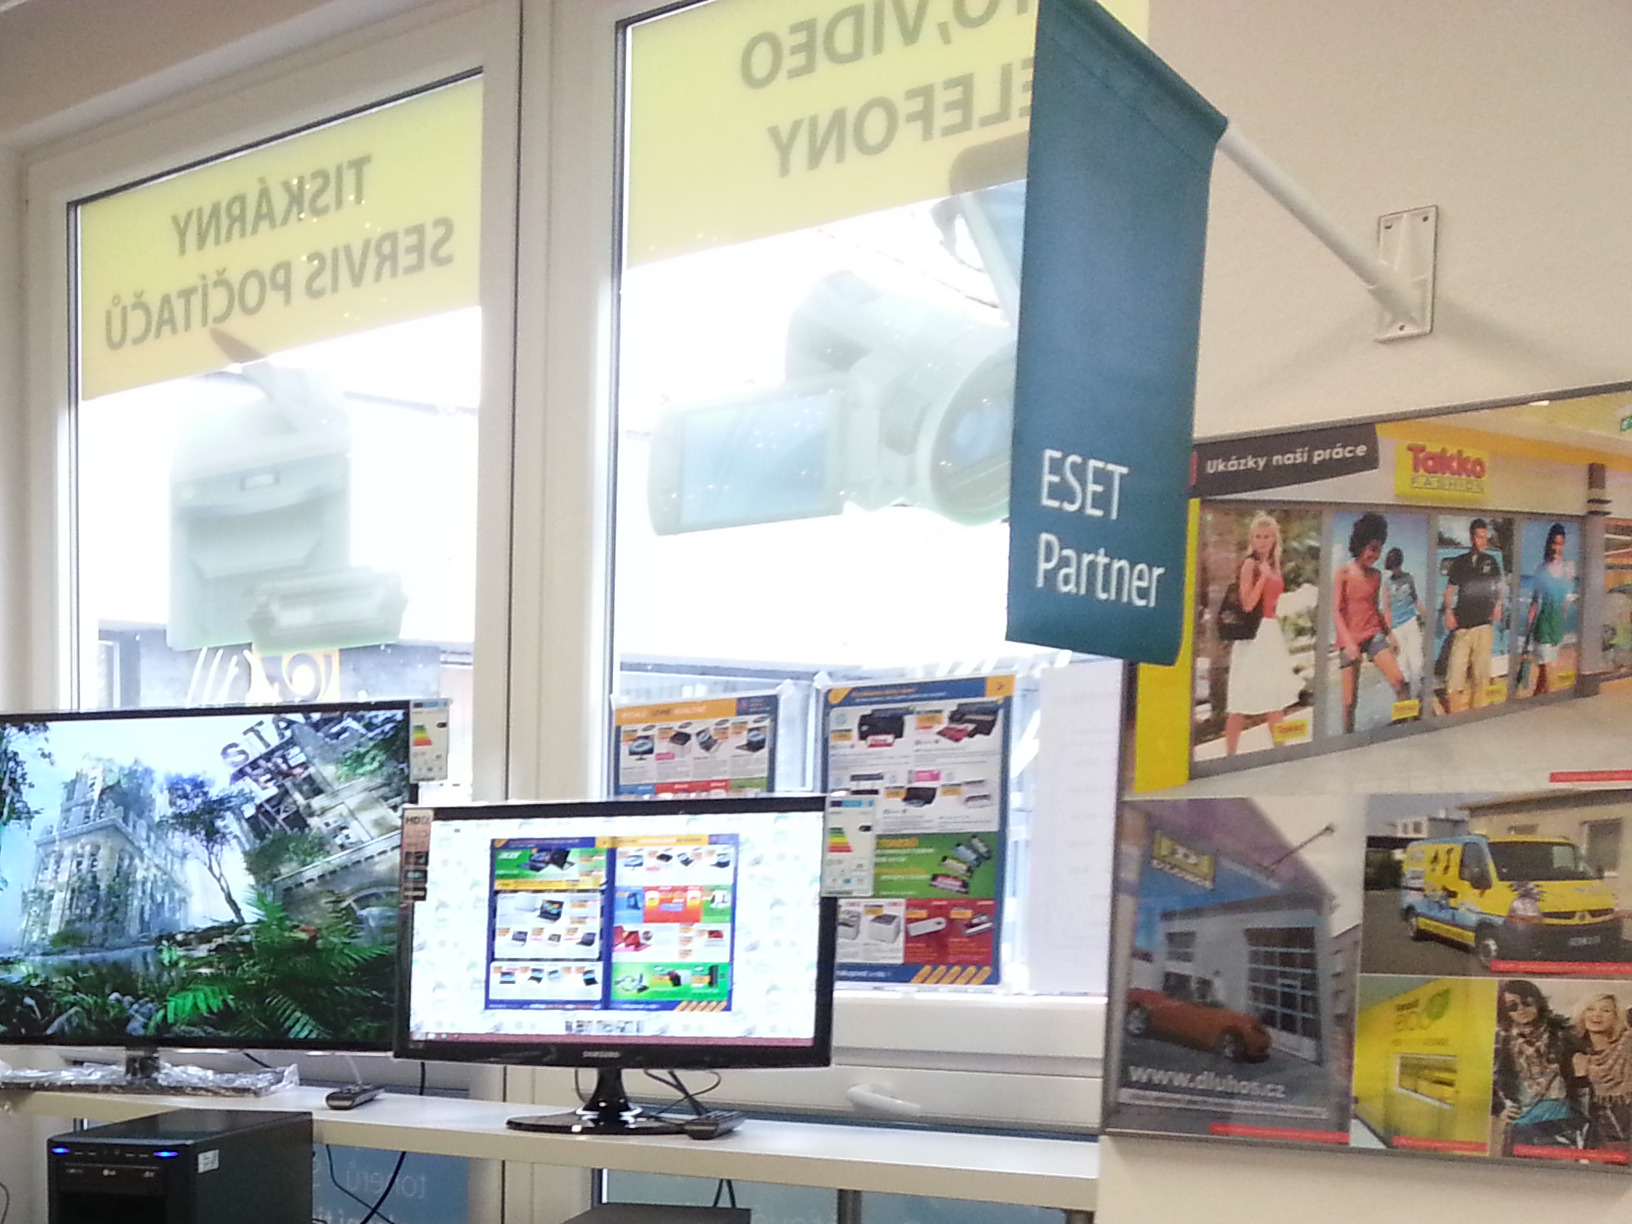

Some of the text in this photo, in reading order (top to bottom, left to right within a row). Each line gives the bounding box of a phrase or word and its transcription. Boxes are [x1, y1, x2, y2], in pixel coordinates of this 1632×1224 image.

[1206, 441, 1369, 475] Ukázky naší práce
[1407, 443, 1487, 480] Takko
[1040, 448, 1130, 521] ESET
[1411, 477, 1486, 494] FASHION
[1036, 531, 1166, 608] Partner
[1128, 1063, 1286, 1100] www.dluhos.cz
